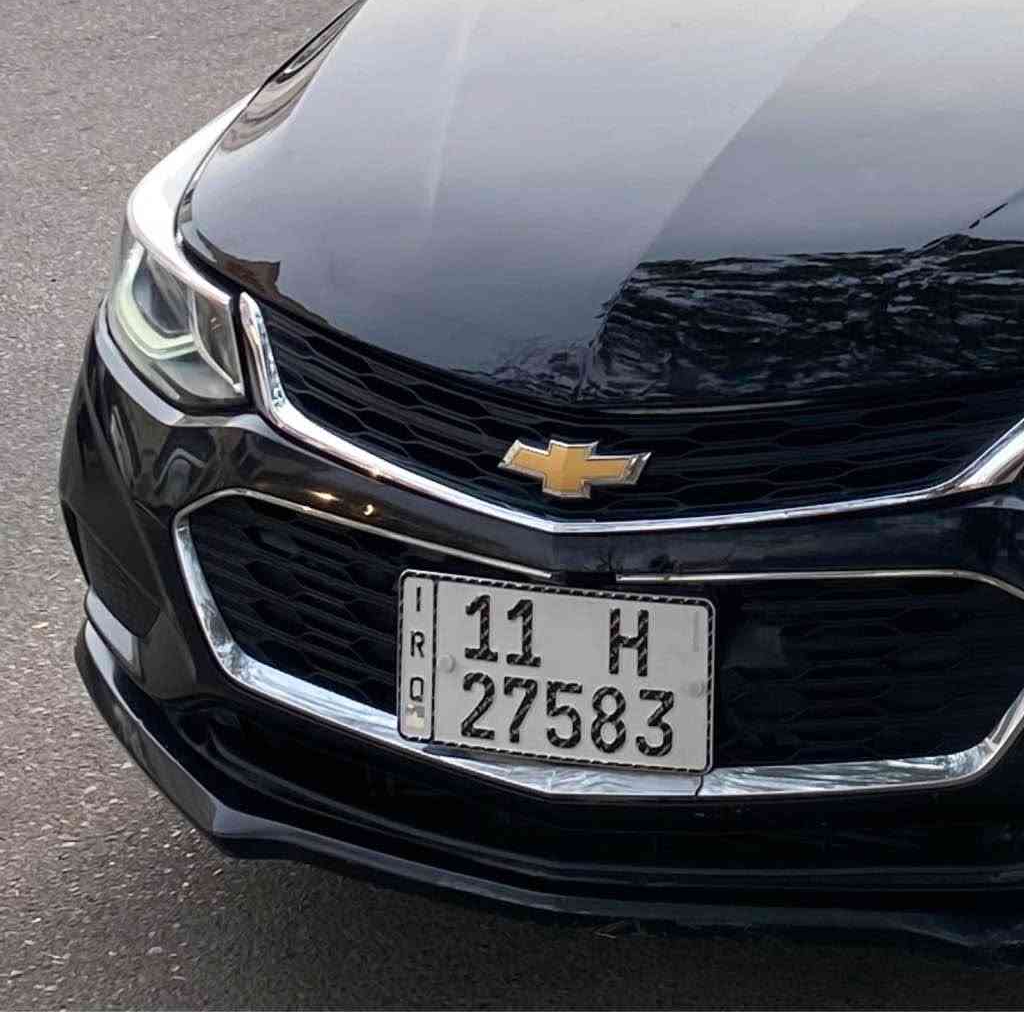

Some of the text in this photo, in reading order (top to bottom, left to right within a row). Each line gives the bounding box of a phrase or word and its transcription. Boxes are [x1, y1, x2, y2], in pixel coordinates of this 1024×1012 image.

[465, 594, 649, 676] 11 H
[461, 672, 675, 757] 27583
